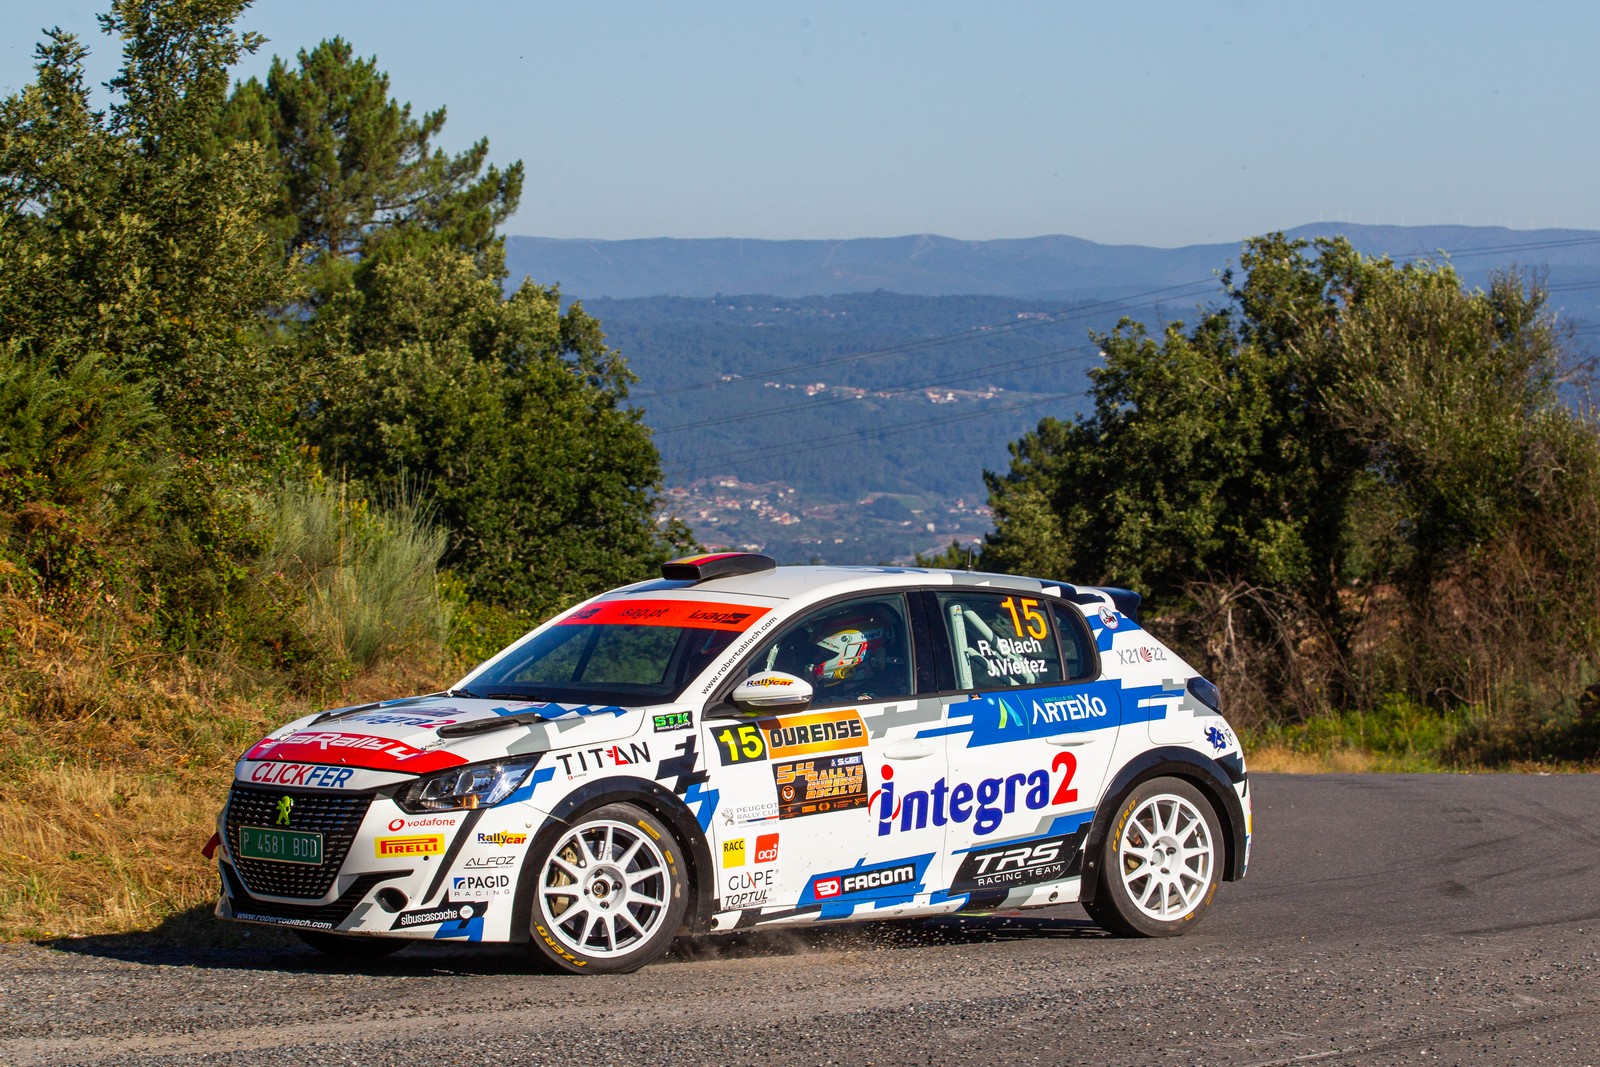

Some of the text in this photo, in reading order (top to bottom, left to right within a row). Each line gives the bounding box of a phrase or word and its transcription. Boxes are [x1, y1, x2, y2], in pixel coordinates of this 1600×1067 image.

[1001, 597, 1048, 640] 15
[977, 636, 1042, 656] R. Blach
[701, 616, 778, 695] www.robertoblach.com
[746, 678, 793, 686] Rallycar
[655, 712, 689, 727] STK
[769, 718, 862, 748] OURENSE
[718, 726, 763, 762] 15
[556, 741, 651, 775] TITAN
[252, 762, 354, 788] CLICKFER
[777, 761, 815, 785] 54
[807, 765, 863, 781] RALLYE
[806, 784, 862, 799] RECALVI
[807, 775, 863, 791] OURENSE
[878, 751, 1078, 837] integra2
[736, 802, 778, 813] PEUGEOT
[737, 810, 761, 820] RALLY
[762, 809, 779, 817] CUP
[407, 818, 456, 828] vodafone
[243, 832, 250, 850] P
[257, 834, 285, 854] 4581
[381, 838, 438, 855] PIRELLI
[478, 833, 527, 844] Rallycar
[723, 841, 744, 852] RACC
[758, 844, 777, 861] acp
[975, 841, 1064, 874] TRS
[465, 856, 516, 867] ALFOZ
[468, 875, 509, 889] PAGID
[844, 866, 914, 892] FACOM
[978, 864, 1061, 886] RACING TEAM
[725, 889, 768, 906] TOPTUL
[401, 908, 458, 925] sibuscascoche
